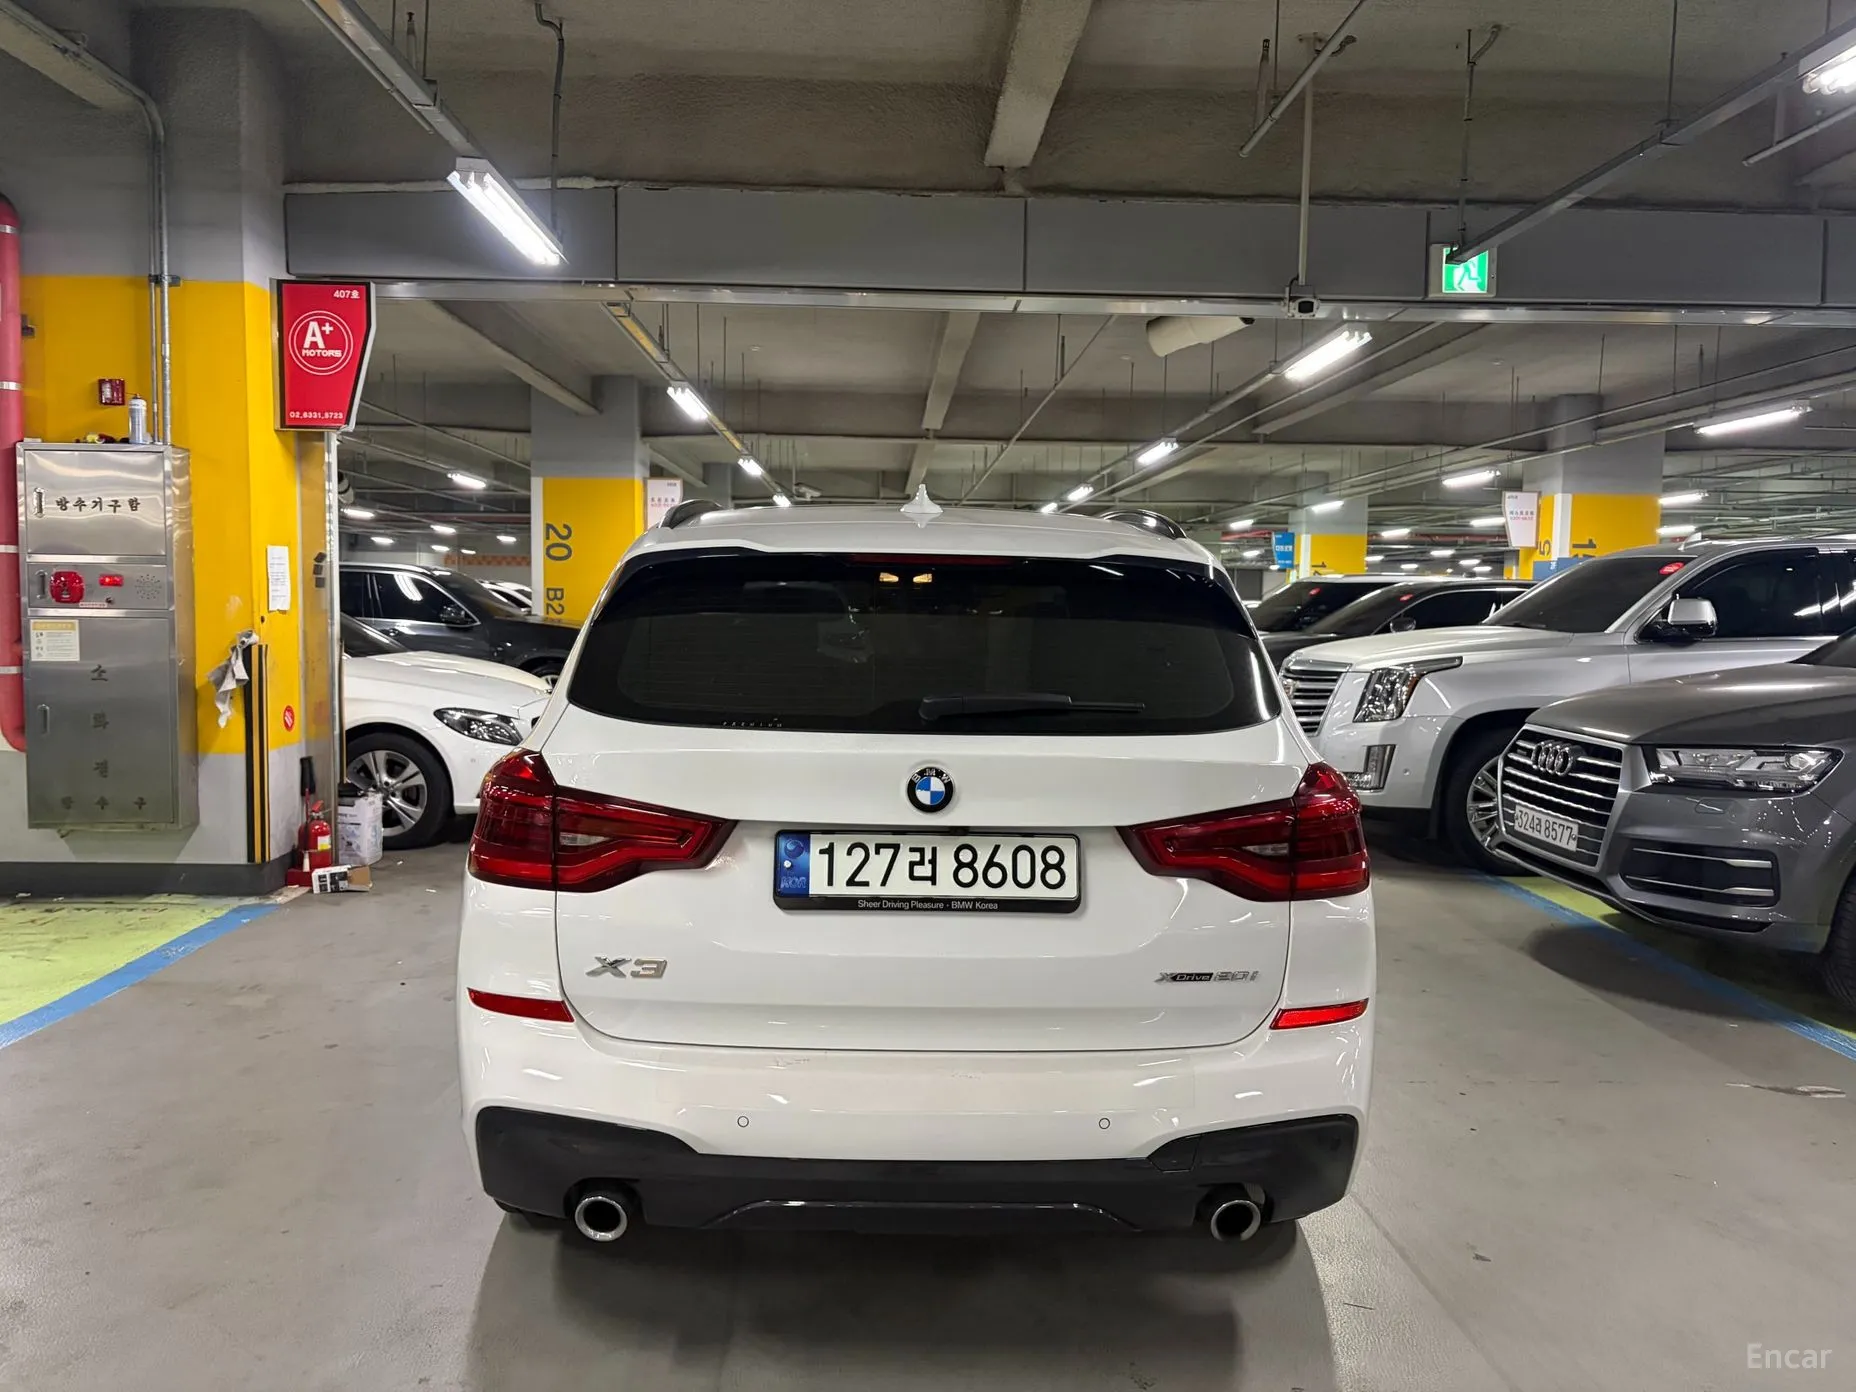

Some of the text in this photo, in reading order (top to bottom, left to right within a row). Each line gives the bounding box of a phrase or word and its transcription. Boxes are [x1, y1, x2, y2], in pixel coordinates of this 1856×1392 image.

[333, 289, 360, 299] 407호
[303, 320, 334, 349] A+
[301, 349, 342, 359] MOTORS
[545, 523, 572, 562] 20
[545, 587, 565, 616] B2
[1544, 819, 1573, 846] 8577
[818, 842, 1067, 890] 127러 8608
[857, 899, 998, 910] Sheer Driving Pleasure BMW Korea
[585, 956, 668, 979] X3
